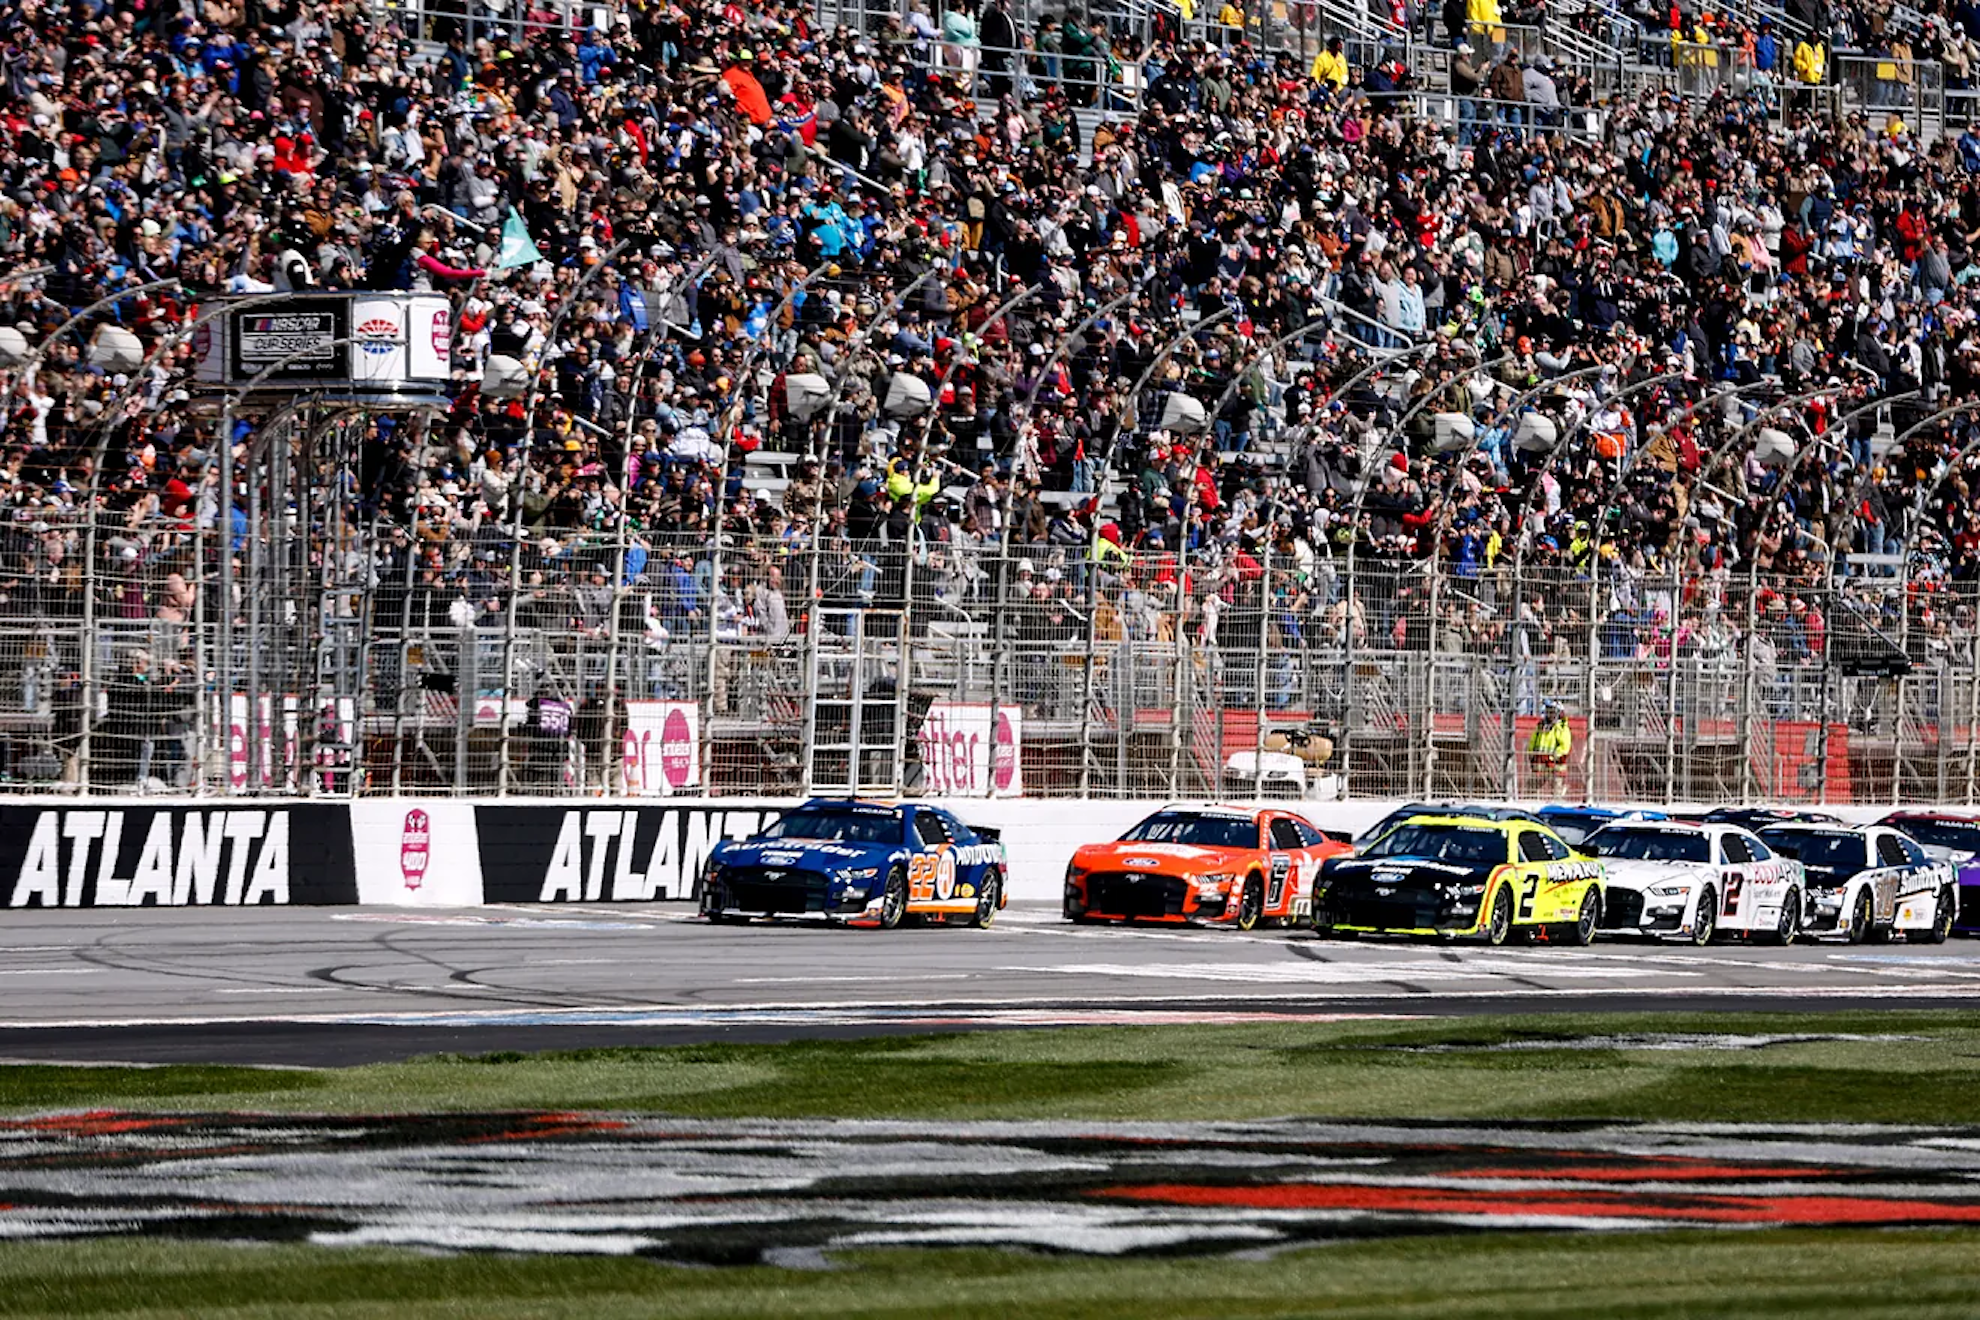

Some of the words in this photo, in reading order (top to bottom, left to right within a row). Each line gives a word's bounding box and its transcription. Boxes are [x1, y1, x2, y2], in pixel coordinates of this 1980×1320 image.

[254, 337, 279, 350] CUP
[281, 336, 321, 352] SERIES
[271, 317, 320, 331] NASCAR
[9, 810, 291, 908] ATLANTA
[402, 851, 427, 872] 400
[907, 852, 940, 901] 22
[1518, 873, 1540, 918] 2
[1720, 871, 1744, 917] 12
